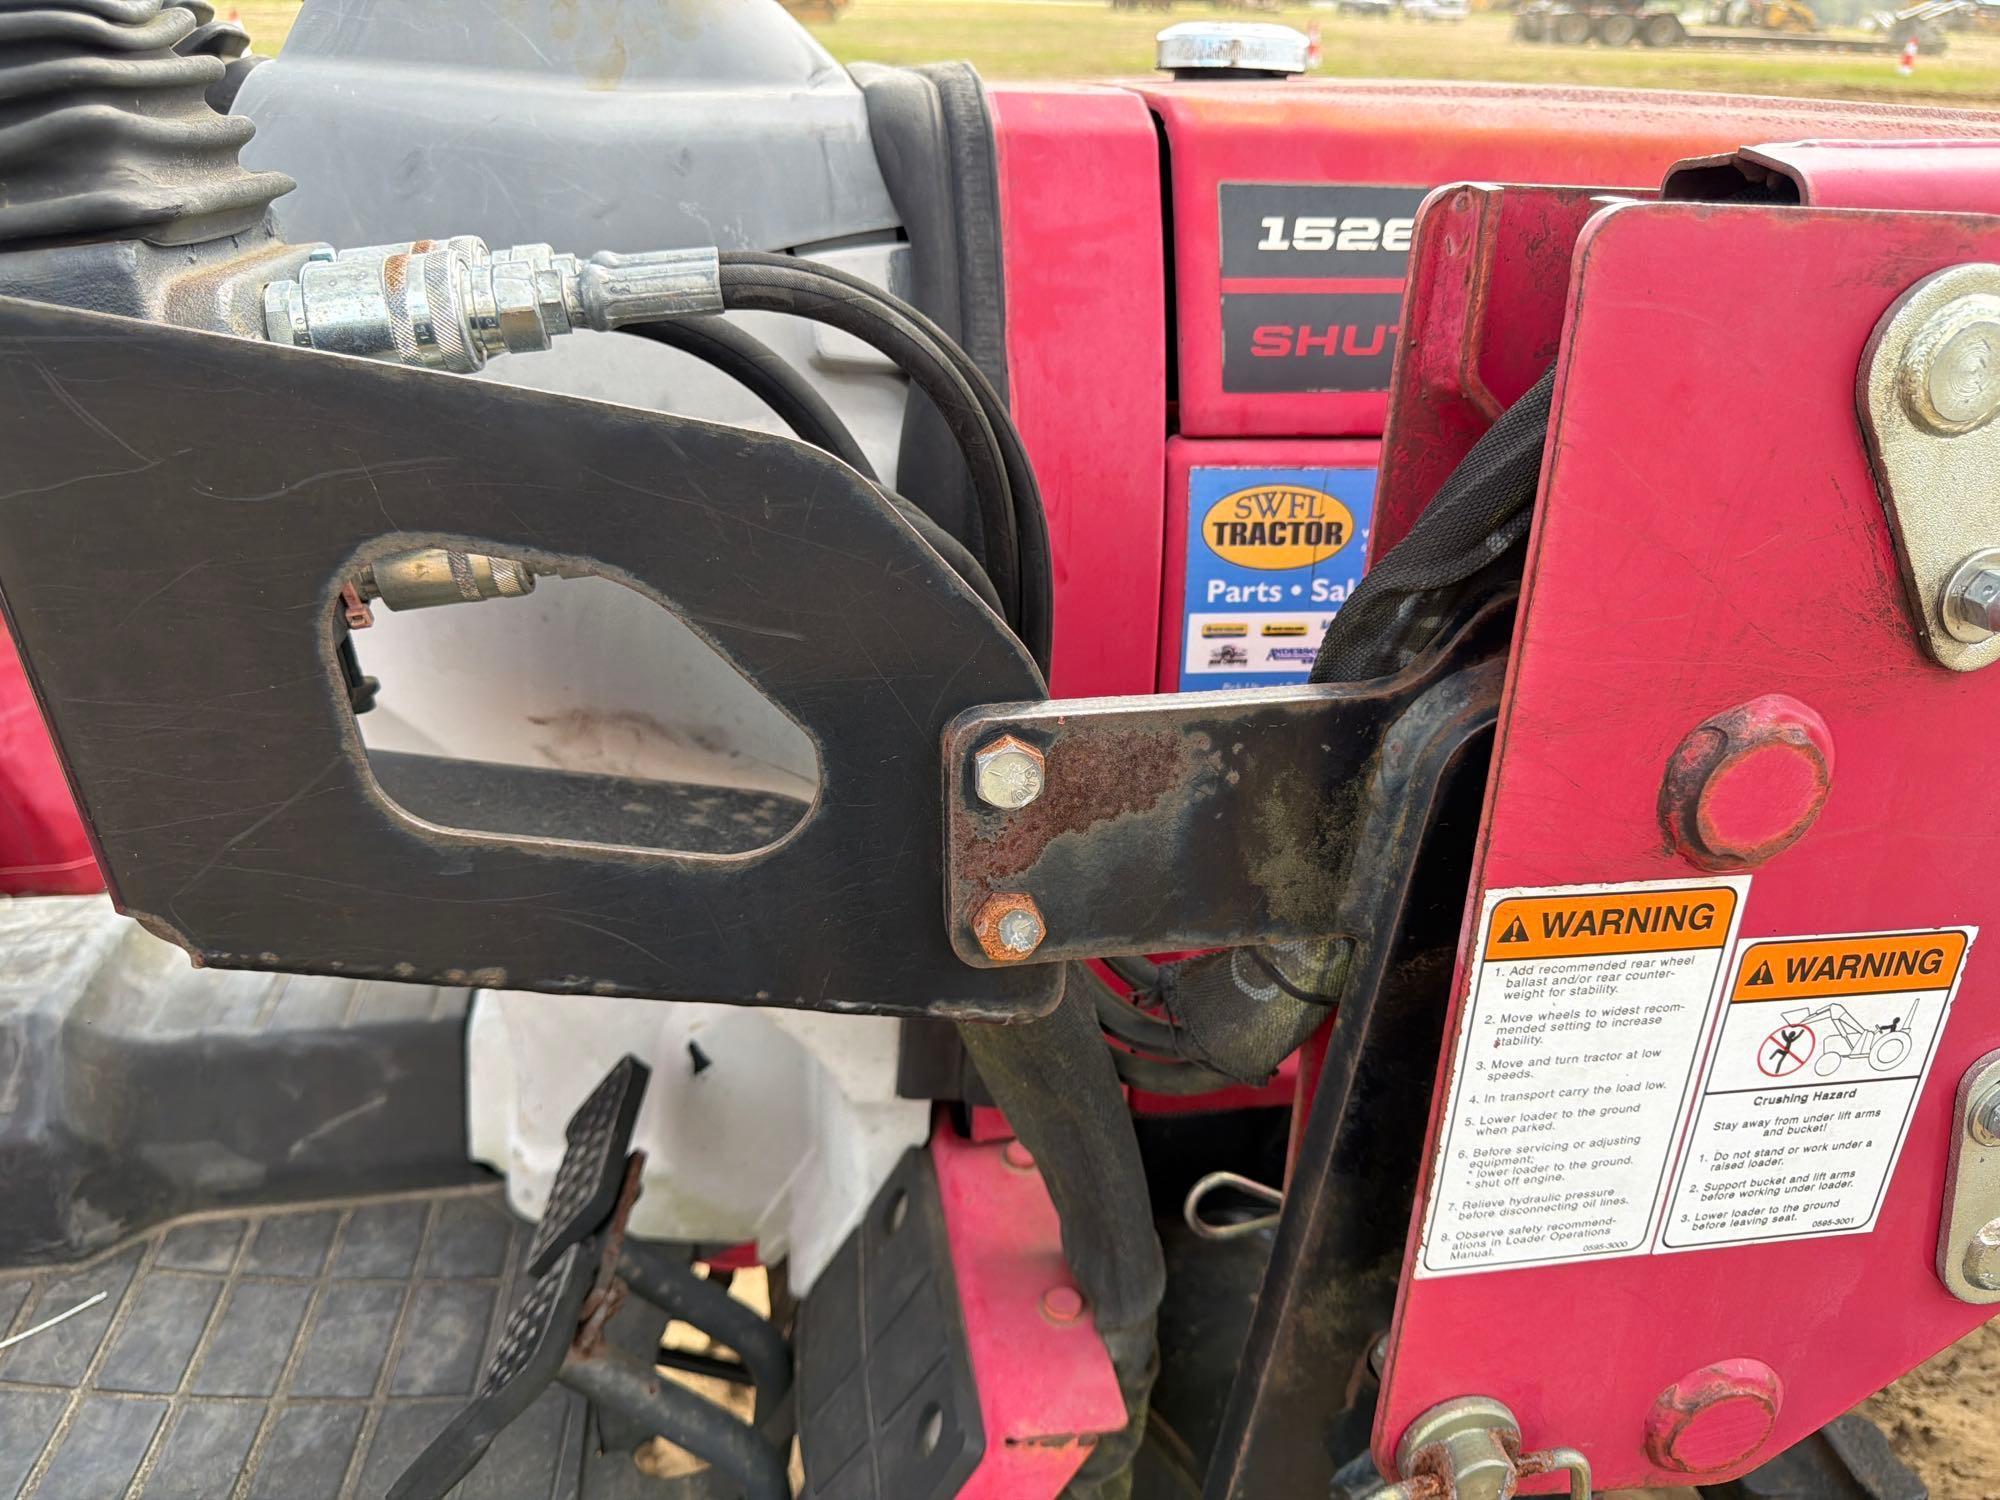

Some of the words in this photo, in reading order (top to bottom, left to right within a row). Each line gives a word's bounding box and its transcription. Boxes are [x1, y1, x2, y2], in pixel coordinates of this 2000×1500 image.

[1258, 217, 1414, 251] 1526
[1234, 491, 1325, 520] SWFL
[1213, 521, 1343, 546] TRACTOR
[1207, 580, 1282, 604] Parts
[1542, 903, 1715, 939] WARNING
[1495, 968, 1504, 978] 1.
[1509, 965, 1533, 976] Add
[1539, 960, 1626, 975] recommended
[1631, 959, 1655, 970] rear
[1660, 955, 1696, 967] wheel
[1786, 949, 1944, 984] WARNING
[1506, 977, 1547, 988] ballast
[1552, 974, 1592, 986] and/or
[1596, 972, 1620, 983] rear
[1625, 970, 1675, 981] counter-
[1503, 989, 1544, 1001] weight
[1549, 986, 1565, 997] for
[1569, 984, 1619, 996] stability.
[1484, 1015, 1496, 1025] 2.
[1500, 1012, 1533, 1024] Move
[1538, 1009, 1580, 1021] wheels
[1585, 1008, 1597, 1018] to
[1601, 1005, 1639, 1017] widest
[1644, 1003, 1685, 1013] recom-
[1496, 1023, 1545, 1035] mended
[1550, 1020, 1591, 1032] setting
[1595, 1019, 1607, 1029] to
[1611, 1016, 1662, 1027] increase
[1494, 1035, 1543, 1048] stability.
[1475, 1061, 1486, 1071] 3.
[1491, 1059, 1523, 1070] Move
[1528, 1057, 1550, 1067] and
[1555, 1055, 1579, 1065] turn
[1583, 1053, 1622, 1063] tractor
[1626, 1050, 1638, 1059] at
[1641, 1048, 1662, 1058] low
[1487, 1070, 1534, 1082] speeds.
[1469, 1095, 1479, 1104] 4.
[1484, 1093, 1496, 1103] In
[1500, 1089, 1554, 1103] transport
[1558, 1087, 1589, 1098] carry
[1593, 1084, 1611, 1095] the
[1615, 1082, 1642, 1093] load
[1645, 1079, 1667, 1090] low.
[1753, 1092, 1809, 1107] Crushing
[1813, 1088, 1857, 1101] Hazard
[1464, 1117, 1475, 1127] 5.
[1479, 1114, 1516, 1125] Lower
[1520, 1111, 1558, 1122] loader
[1561, 1109, 1573, 1118] to
[1577, 1107, 1596, 1117] the
[1600, 1103, 1641, 1117] ground
[1713, 1120, 1739, 1132] Stay
[1742, 1118, 1771, 1129] away
[1774, 1115, 1799, 1125] from
[1803, 1112, 1835, 1123] under
[1838, 1110, 1852, 1120] lift
[1855, 1109, 1881, 1119] arms
[1476, 1125, 1507, 1136] when
[1512, 1122, 1555, 1134] parked.
[1763, 1128, 1783, 1137] and
[1787, 1123, 1827, 1135] bucket!
[1457, 1149, 1468, 1159] 6.
[1473, 1146, 1511, 1158] Before
[1516, 1142, 1569, 1155] servicing
[1573, 1140, 1586, 1149] or
[1589, 1136, 1642, 1149] adjusting
[1700, 1154, 1708, 1162] 1.
[1714, 1152, 1729, 1162] Do
[1733, 1151, 1751, 1160] not
[1754, 1147, 1784, 1158] stand
[1788, 1146, 1800, 1155] or
[1803, 1143, 1828, 1153] work
[1832, 1140, 1863, 1150] under
[1866, 1139, 1873, 1147] a
[1477, 1168, 1509, 1178] lower
[1512, 1165, 1550, 1176] loader
[1554, 1163, 1565, 1172] to
[1569, 1159, 1588, 1170] the
[1591, 1156, 1634, 1169] ground.
[1710, 1161, 1745, 1172] raised
[1748, 1158, 1784, 1168] loader.
[1474, 1179, 1500, 1189] shut
[1503, 1176, 1520, 1186] off
[1523, 1173, 1565, 1186] engine.
[1689, 1185, 1699, 1193] 2.
[1704, 1180, 1747, 1193] Support
[1750, 1176, 1786, 1187] bucket
[1789, 1174, 1809, 1184] and
[1813, 1173, 1827, 1181] lift
[1830, 1170, 1856, 1180] arms
[1701, 1191, 1735, 1202] before
[1739, 1187, 1781, 1198] working
[1784, 1183, 1816, 1194] under
[1819, 1180, 1854, 1191] loader.
[1448, 1203, 1458, 1212] 7.
[1462, 1199, 1505, 1210] Relieve
[1509, 1193, 1561, 1207] hydraulic
[1564, 1189, 1615, 1202] pressure
[1458, 1209, 1495, 1220] before
[1499, 1201, 1578, 1217] disconnecting
[1582, 1199, 1596, 1209] oil
[1599, 1197, 1629, 1207] lines.
[1681, 1215, 1690, 1223] 3.
[1695, 1211, 1728, 1222] Lower
[1731, 1208, 1765, 1218] loader
[1769, 1206, 1779, 1214] to
[1783, 1204, 1799, 1213] the
[1802, 1200, 1840, 1211] ground
[1441, 1233, 1451, 1242] 8.
[1455, 1229, 1504, 1241] Observe
[1508, 1224, 1543, 1236] safety
[1546, 1217, 1617, 1231] recommend-
[1691, 1221, 1726, 1231] before
[1730, 1216, 1768, 1229] leaving
[1772, 1214, 1797, 1223] seat.
[1452, 1240, 1486, 1251] ations
[1490, 1238, 1501, 1247] in
[1505, 1234, 1545, 1246] Loader
[1550, 1228, 1611, 1242] Operations
[1449, 1249, 1495, 1261] Manual.
